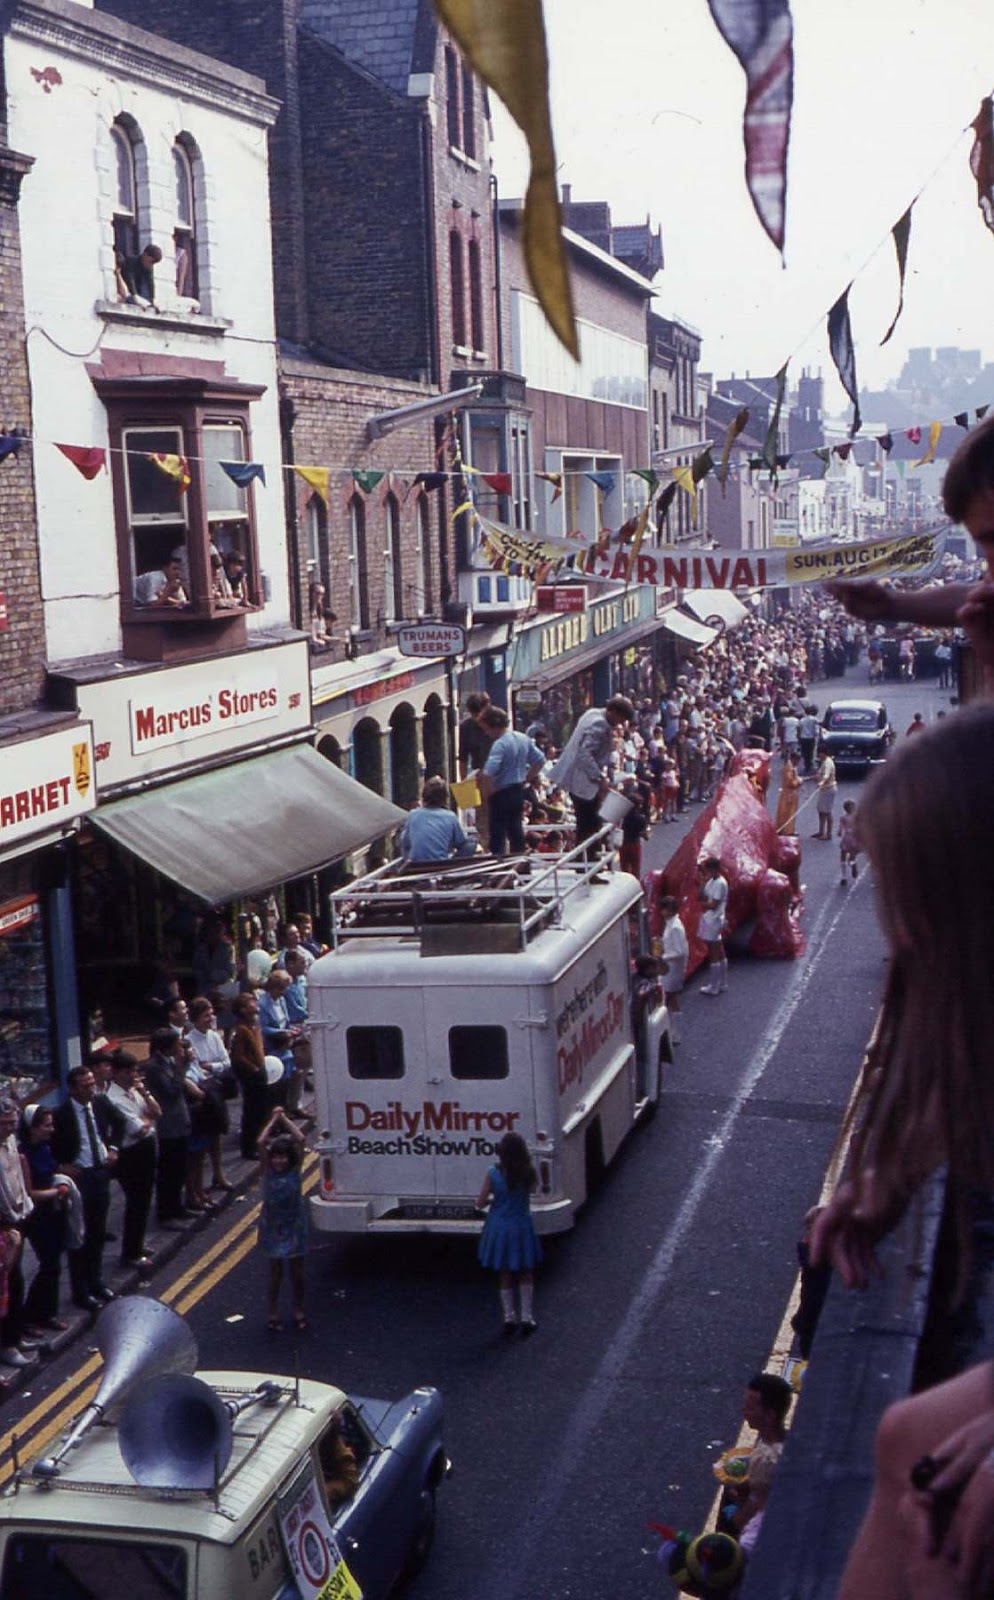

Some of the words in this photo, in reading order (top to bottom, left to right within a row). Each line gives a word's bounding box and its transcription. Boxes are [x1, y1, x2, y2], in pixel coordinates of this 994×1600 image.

[584, 544, 777, 590] CARNIVAL
[412, 642, 451, 653] BEERS
[541, 614, 588, 662] ALFRED
[218, 687, 277, 719] Stores
[345, 1102, 421, 1139] Daily
[423, 1101, 520, 1132] Mirror
[348, 1136, 411, 1155] Beach
[412, 1132, 471, 1156] Show
[470, 1137, 502, 1156] To
